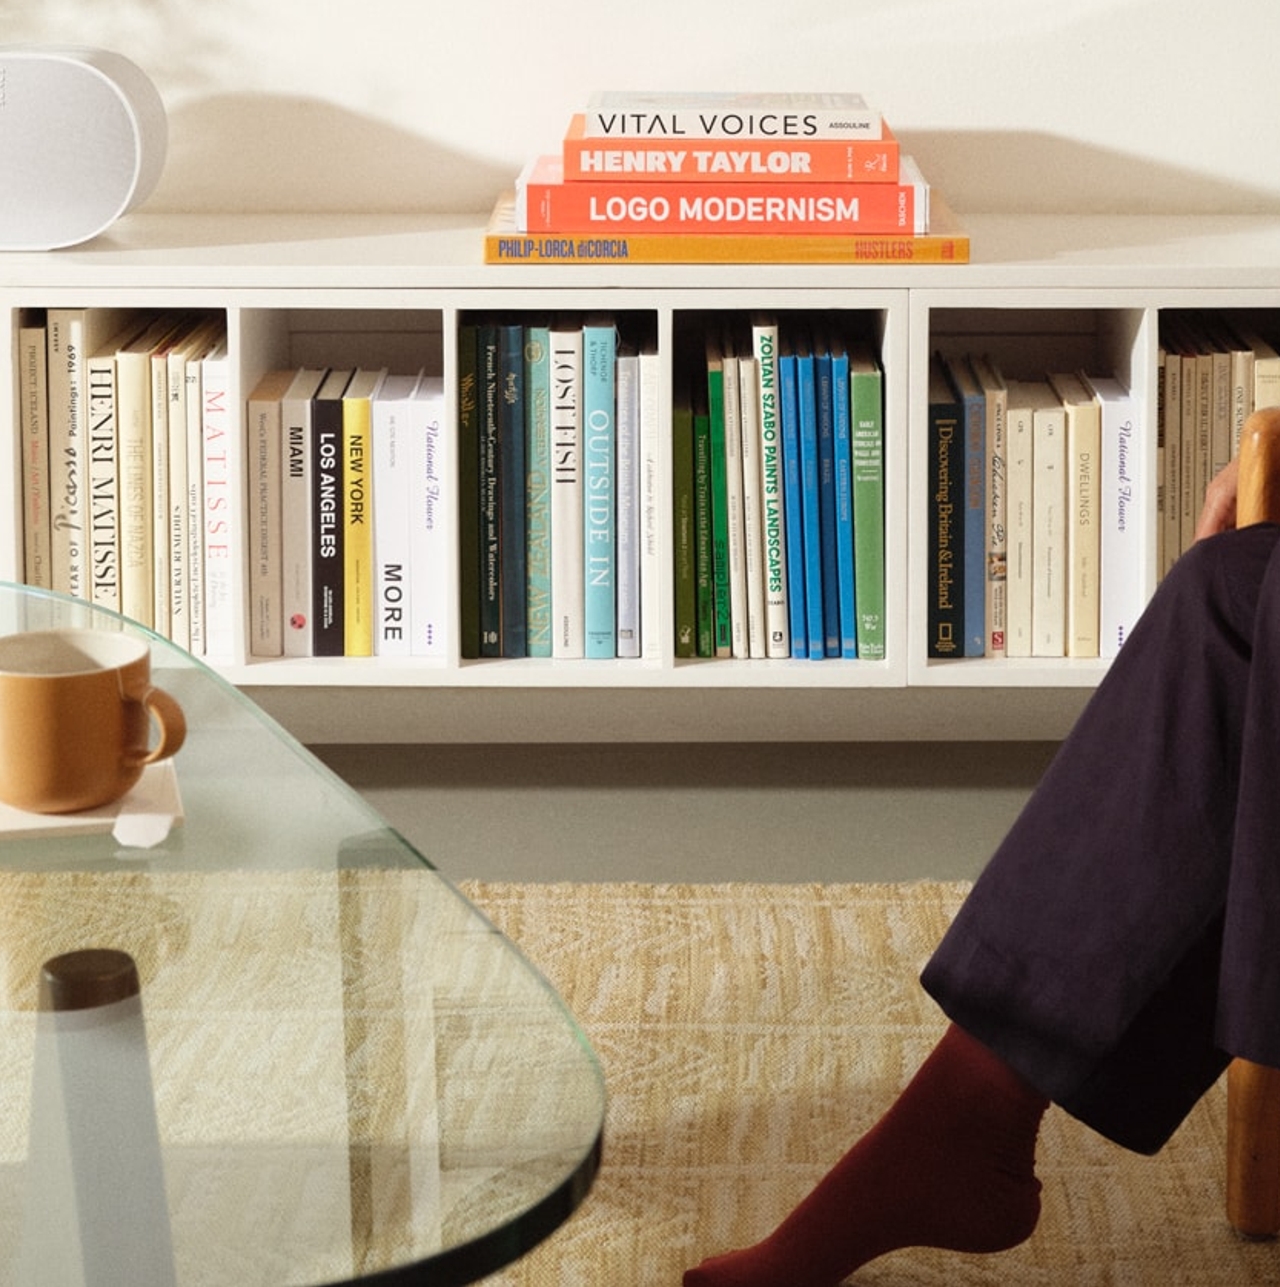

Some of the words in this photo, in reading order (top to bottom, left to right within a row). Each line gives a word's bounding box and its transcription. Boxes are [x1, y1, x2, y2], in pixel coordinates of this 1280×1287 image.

[598, 114, 686, 136] VITAL
[699, 114, 818, 136] VOICES
[828, 120, 871, 130] ASSOULINE
[580, 150, 686, 173] HENRY
[692, 150, 812, 173] TAYLOR
[590, 196, 670, 222] LOGO
[678, 196, 859, 223] MODERNISM
[897, 191, 907, 228] TASCHEN
[498, 239, 575, 259] PHILIP-LORCA
[577, 238, 629, 259] diCORCIA
[854, 240, 914, 260] HUSTLERS
[66, 344, 77, 374] 1969
[485, 345, 496, 379] French
[760, 335, 774, 389] ZOLTAN
[554, 349, 576, 418] LOST
[67, 380, 78, 438] Paintings:
[90, 368, 114, 463] HENRI
[486, 381, 497, 473] Nineteenth-Century
[762, 393, 776, 442] SZABO
[206, 390, 229, 560] MATISSE
[289, 426, 304, 478] MIAMI
[320, 432, 336, 470] LOS
[349, 434, 363, 473] NEW
[425, 420, 439, 482] National
[554, 424, 577, 485] FISH
[697, 434, 708, 473] Travelling
[764, 446, 779, 495] PAINTS
[936, 426, 953, 501] Discovering
[1116, 420, 1132, 484] National
[53, 447, 82, 533] Picasso
[486, 476, 497, 522] Drawings
[588, 409, 611, 544] OUTSIDE
[699, 486, 709, 508] Train
[991, 451, 1006, 518] Chicken
[1079, 452, 1091, 527] DWELLINGS
[320, 472, 336, 558] ANGELES
[350, 477, 364, 526] YORK
[425, 485, 440, 531] Flower
[526, 470, 551, 578] ZEALAND
[938, 503, 954, 547] Britain
[1116, 486, 1132, 533] Flower
[70, 541, 79, 558] OF
[92, 476, 116, 600] MATISSE
[487, 523, 497, 541] and
[700, 530, 709, 572] Edwardian
[766, 498, 783, 594] LANDSCAPES
[939, 549, 953, 562] &
[991, 522, 1005, 549] Pie
[174, 567, 182, 615] NATURAL
[488, 543, 498, 602] Watercolors
[588, 555, 610, 589] IN
[699, 573, 710, 588] Age
[713, 540, 730, 621] sampler2
[939, 563, 954, 609] Ireland
[384, 563, 403, 641] MORE
[527, 584, 551, 645] NEW
